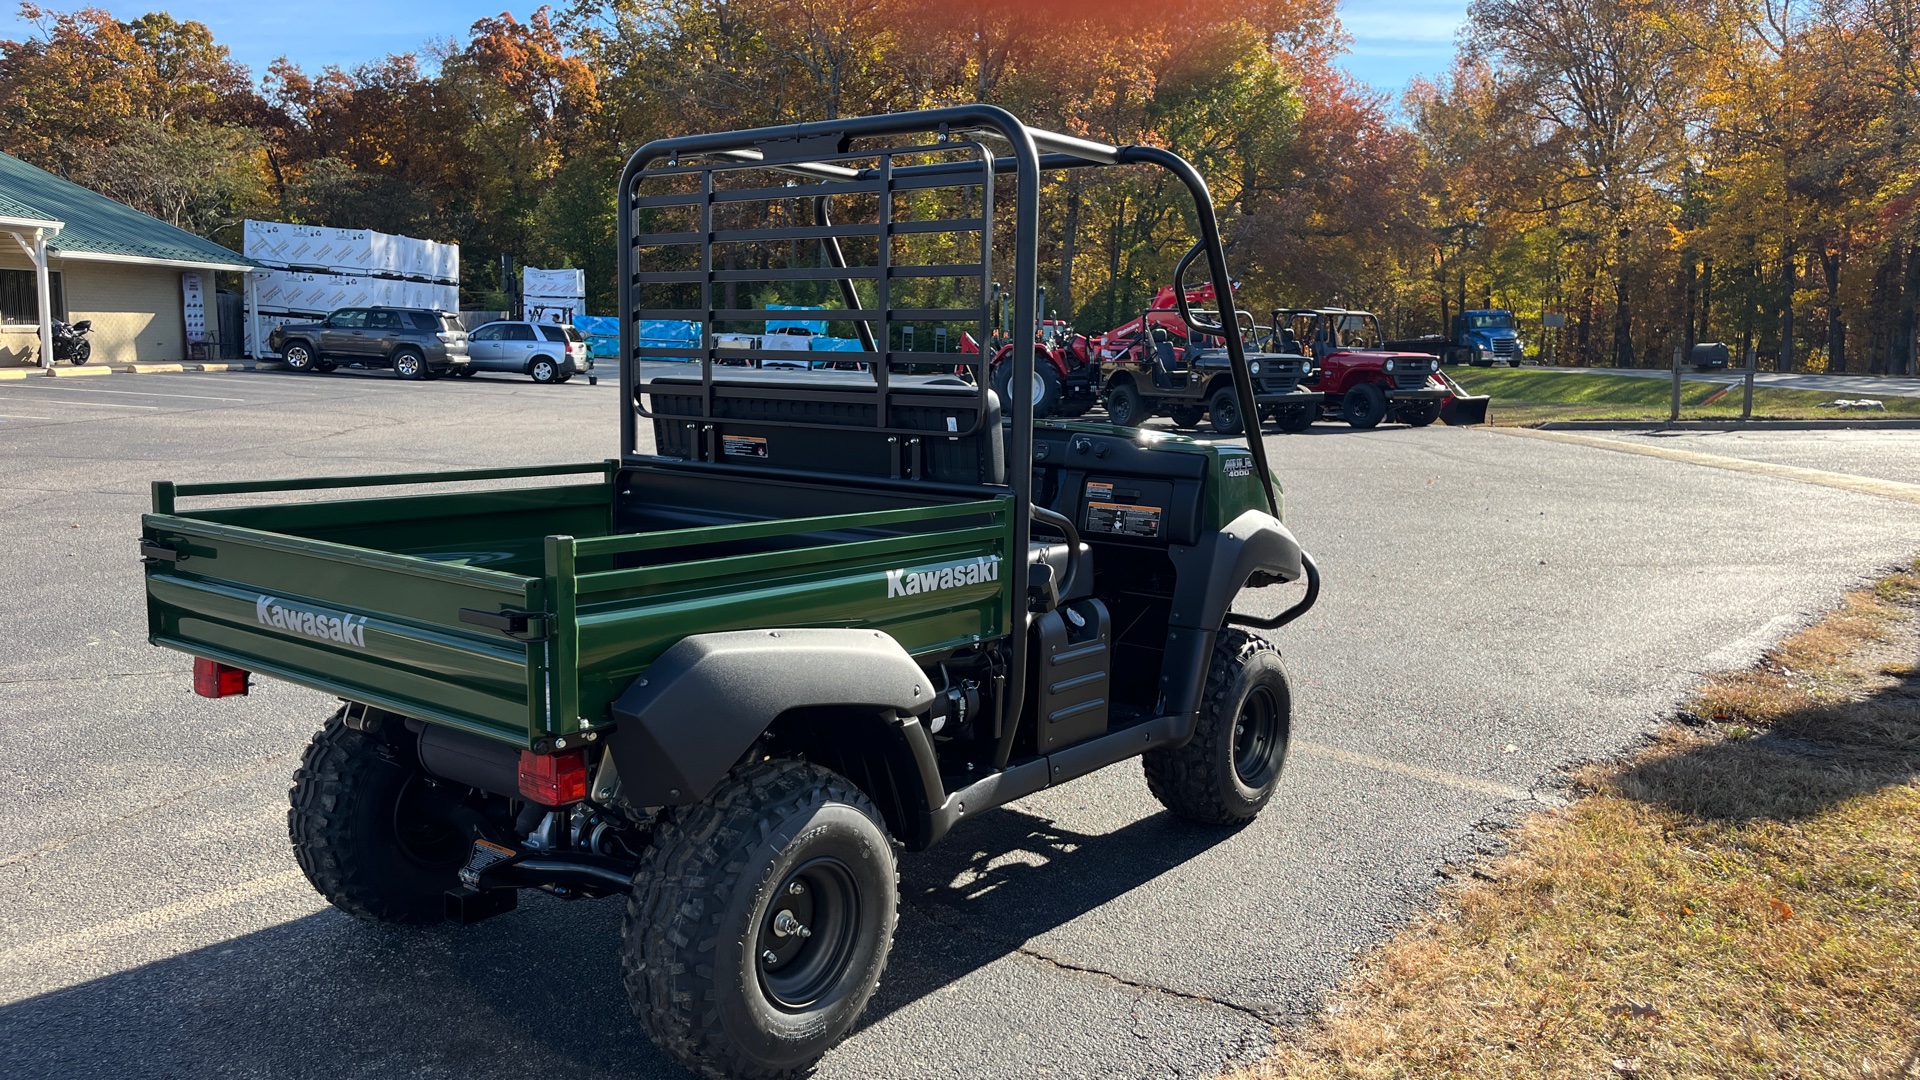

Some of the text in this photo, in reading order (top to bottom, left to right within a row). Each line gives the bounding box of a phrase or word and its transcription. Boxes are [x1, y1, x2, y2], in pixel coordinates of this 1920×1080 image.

[1228, 469, 1250, 477] 4000
[886, 554, 998, 599] Kawasaki
[256, 594, 368, 648] Kawasaki
